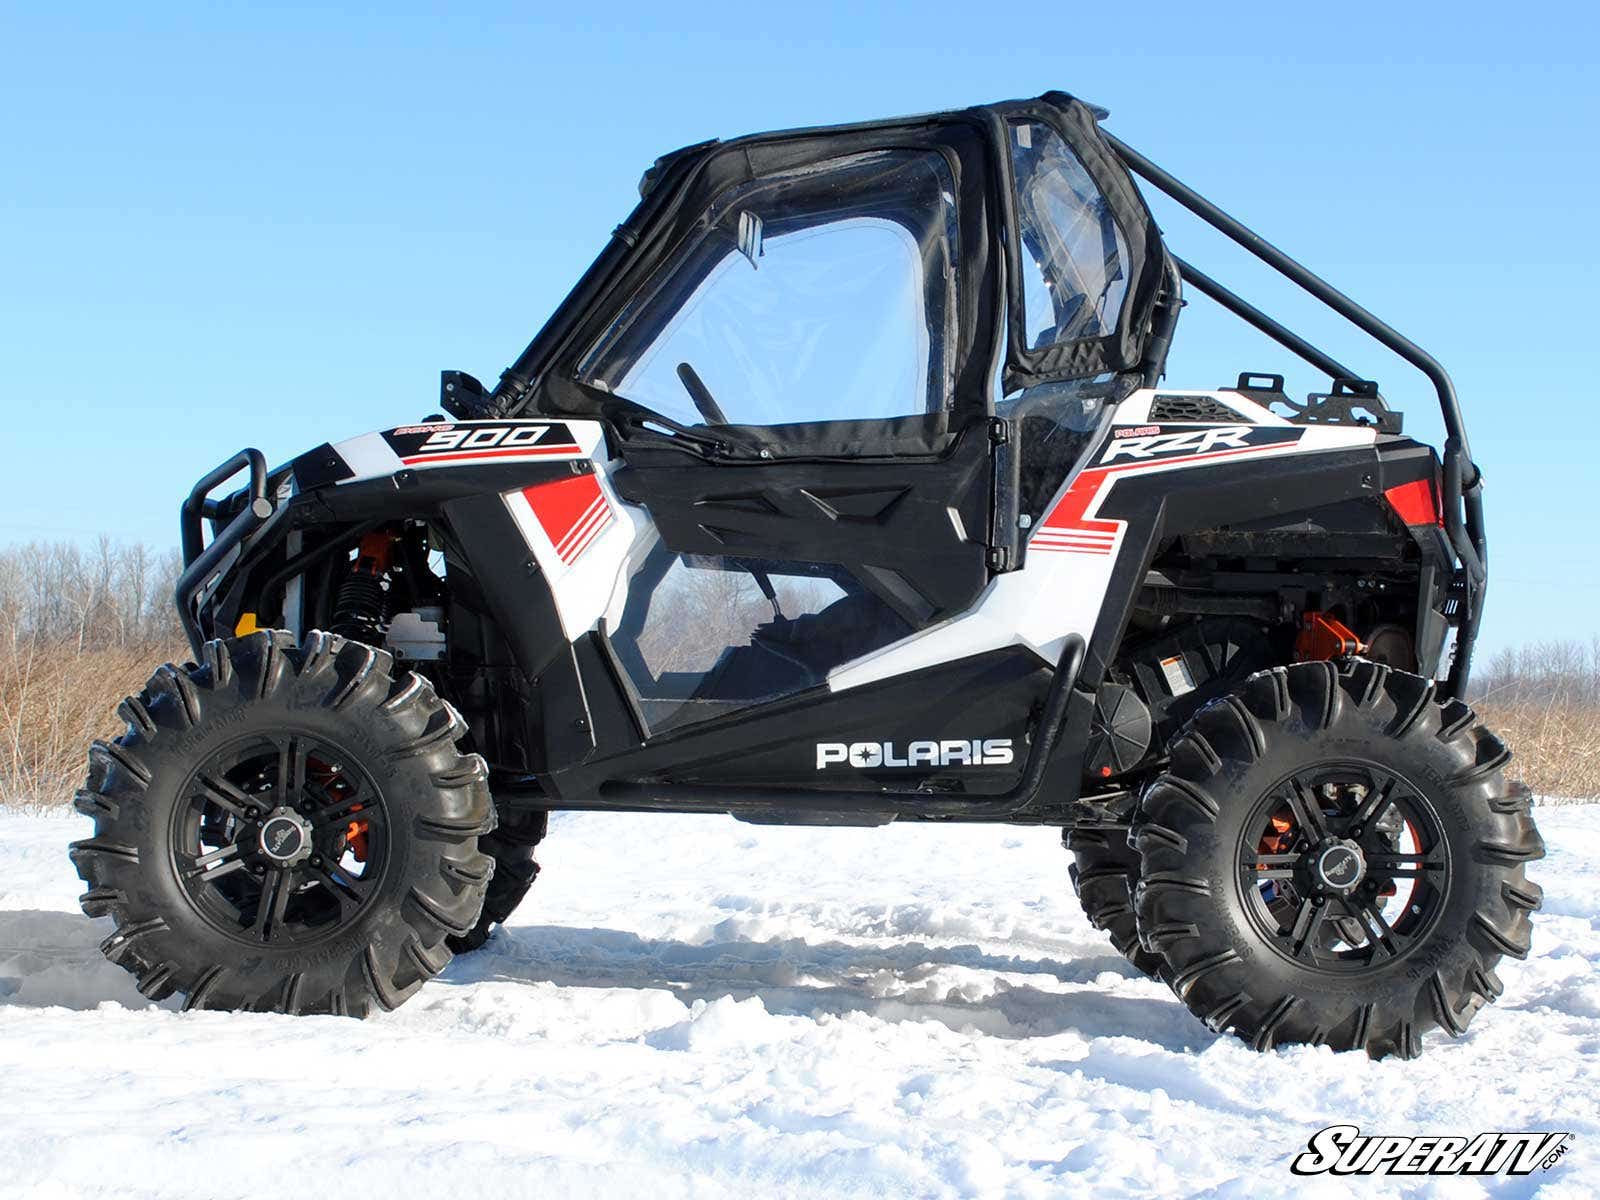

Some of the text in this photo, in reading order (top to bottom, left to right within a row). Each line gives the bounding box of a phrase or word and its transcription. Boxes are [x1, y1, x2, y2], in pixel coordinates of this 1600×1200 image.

[419, 425, 550, 452] 900
[1099, 426, 1254, 465] RZR
[1114, 425, 1161, 439] POLARIS
[816, 739, 1014, 770] POLARIS
